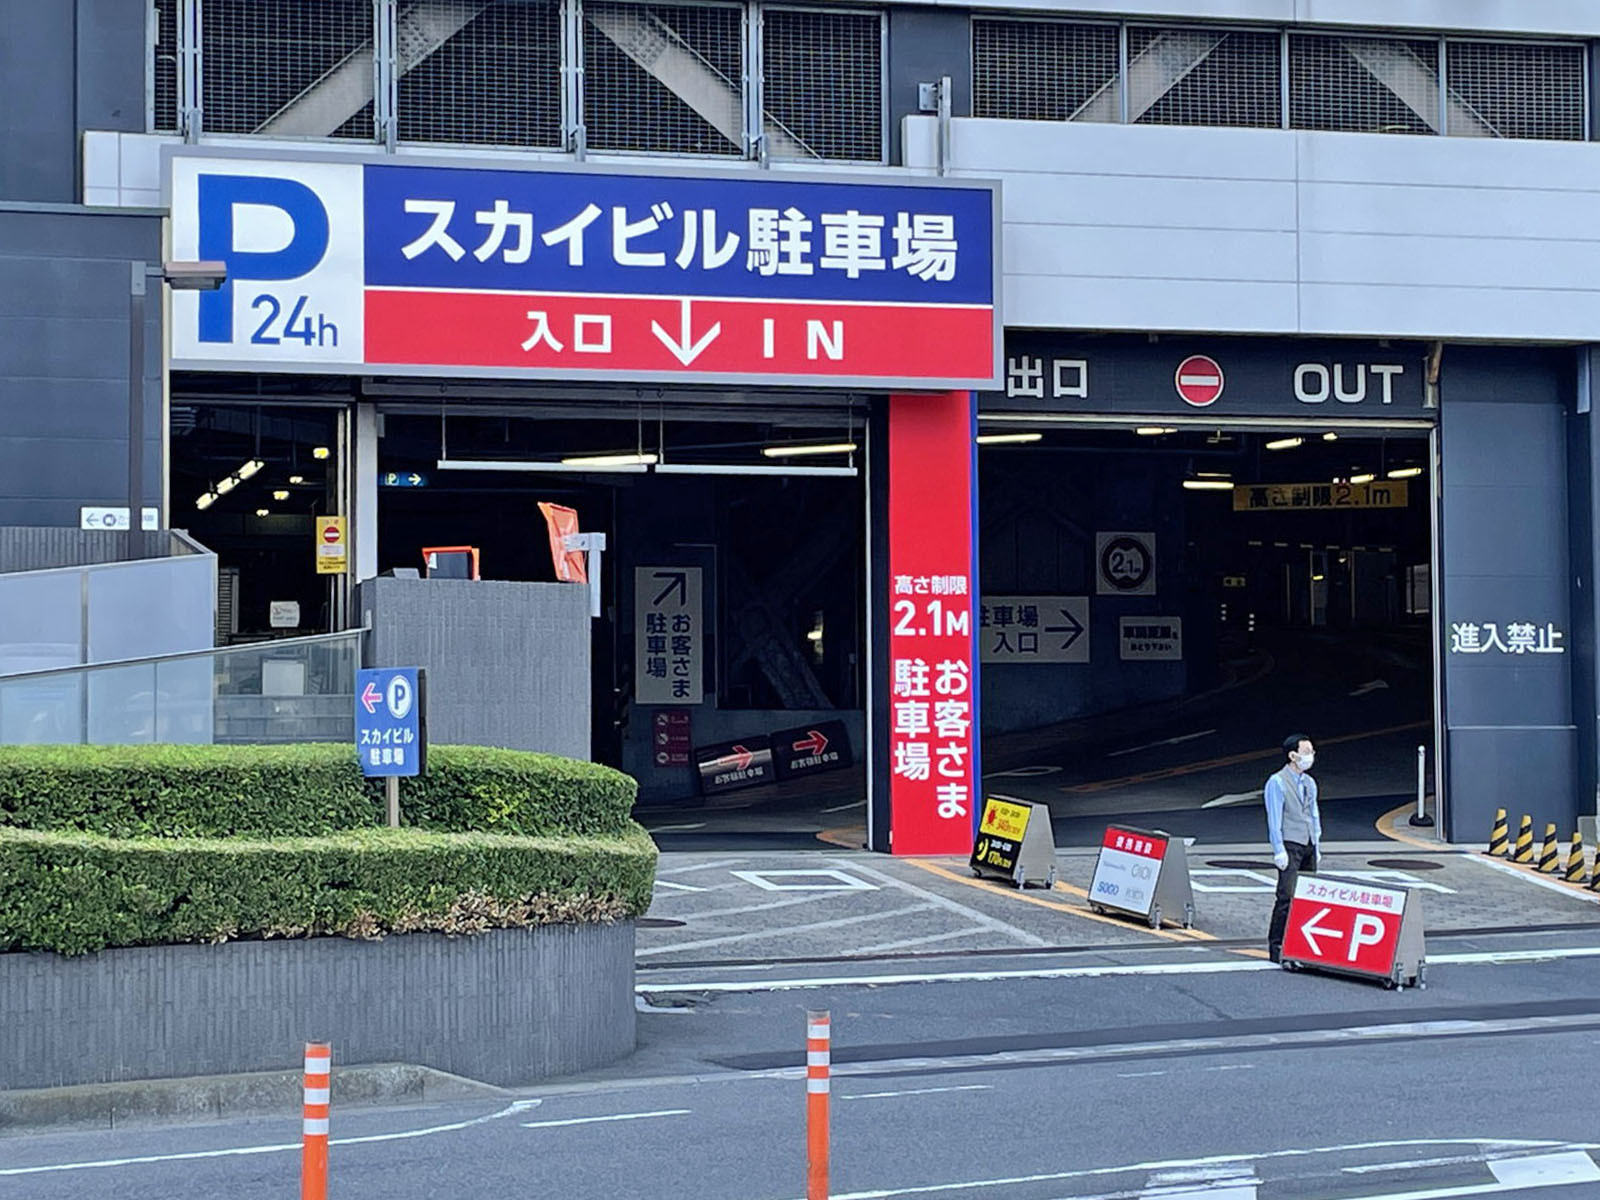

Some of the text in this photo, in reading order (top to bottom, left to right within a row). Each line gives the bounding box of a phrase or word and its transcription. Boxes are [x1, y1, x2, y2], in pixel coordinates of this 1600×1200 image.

[198, 173, 330, 343] P
[401, 199, 958, 281] スカイビル駐車場
[251, 294, 338, 347] 24h
[521, 311, 844, 360] 入口 IN
[1007, 355, 1088, 398] 出口
[1294, 363, 1403, 404] OUT
[894, 575, 967, 595] 高さ制限
[893, 600, 969, 637] 2.1M
[1451, 622, 1564, 654] 進入禁止
[646, 613, 667, 678] 駐車場
[671, 614, 692, 698] お客さま
[993, 632, 1038, 654] 入口
[394, 684, 406, 710] P
[894, 658, 930, 781] 駐車場
[361, 727, 414, 745] スカイビル
[934, 659, 971, 819] お客さま
[1307, 883, 1394, 909] スカイビル駐車場
[1347, 912, 1386, 962] P
